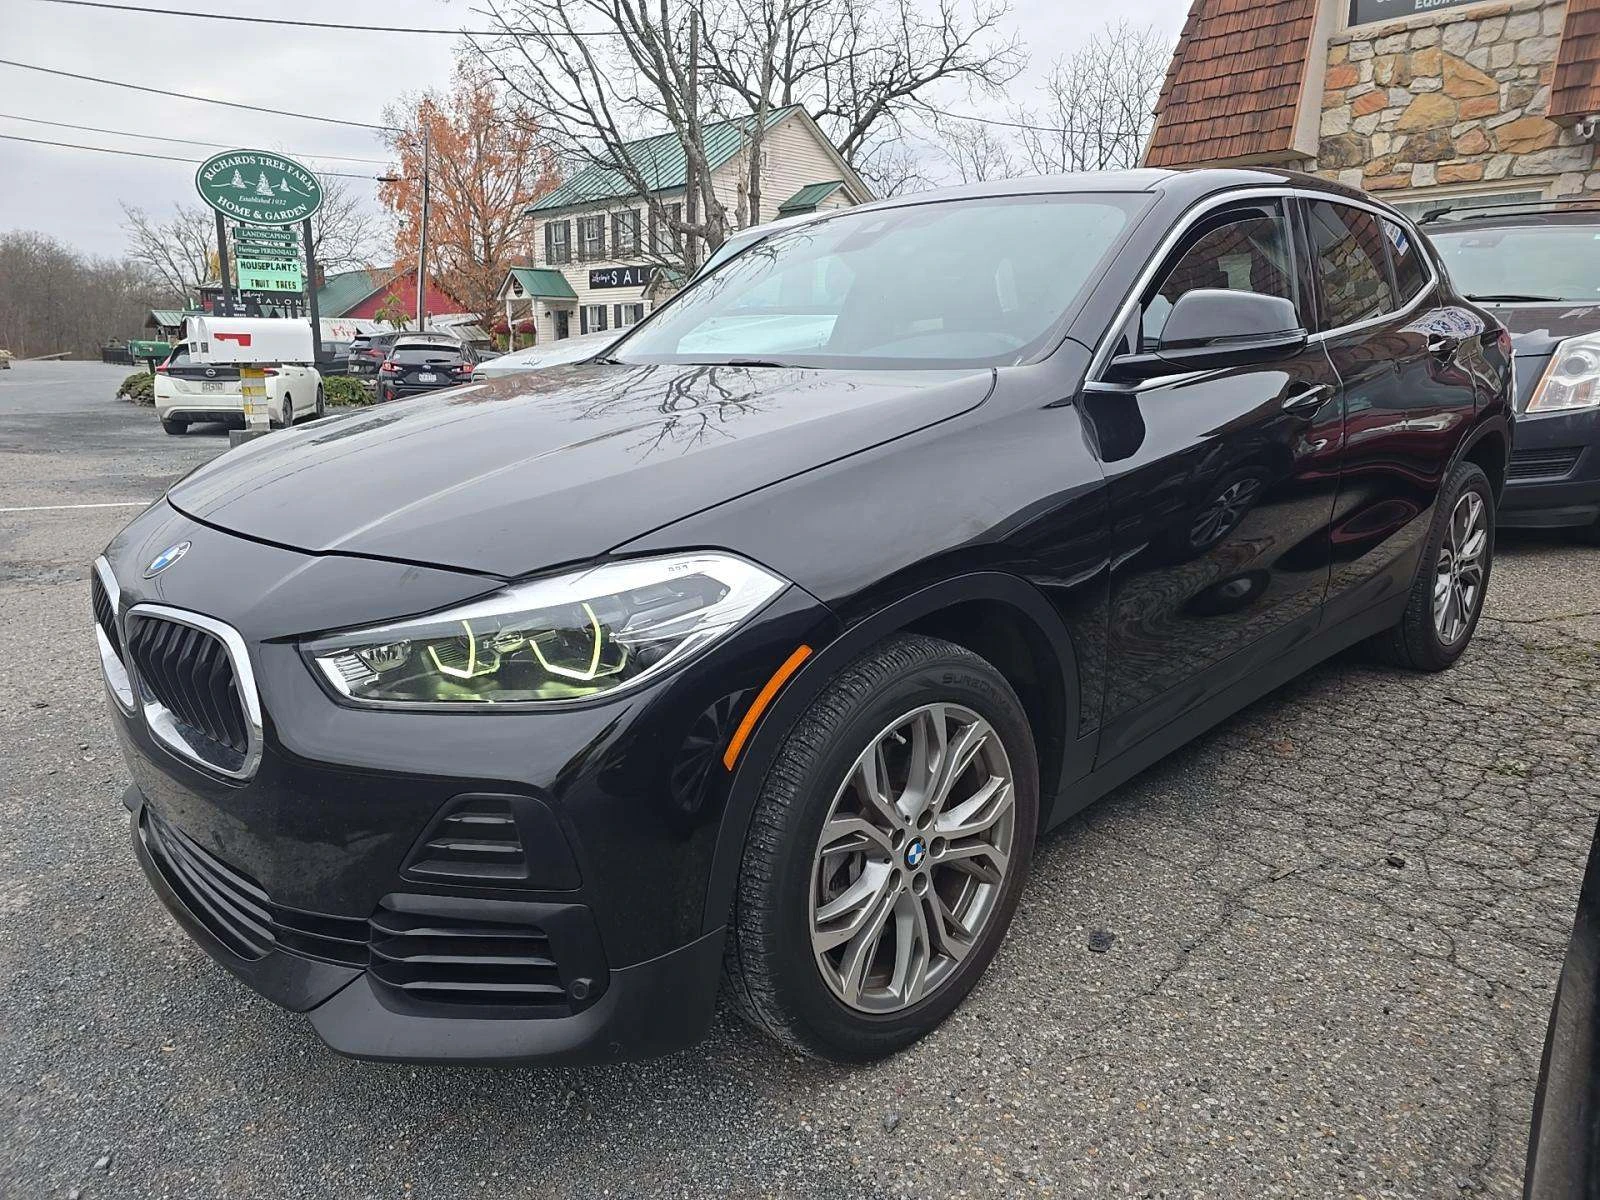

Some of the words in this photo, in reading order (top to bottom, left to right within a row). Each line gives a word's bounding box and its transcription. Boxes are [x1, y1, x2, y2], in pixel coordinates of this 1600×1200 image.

[203, 155, 256, 182] RICHARDS
[258, 156, 285, 171] TREE
[287, 165, 316, 192] FARM
[217, 195, 251, 218] HOME
[253, 210, 263, 220] &
[264, 203, 308, 221] GARDEN
[242, 230, 291, 240] LANDSCAPING
[261, 247, 296, 256] PERENNIALS
[240, 260, 298, 272] HOUSEPLANTS
[275, 280, 297, 290] TREES
[256, 297, 303, 306] SALON
